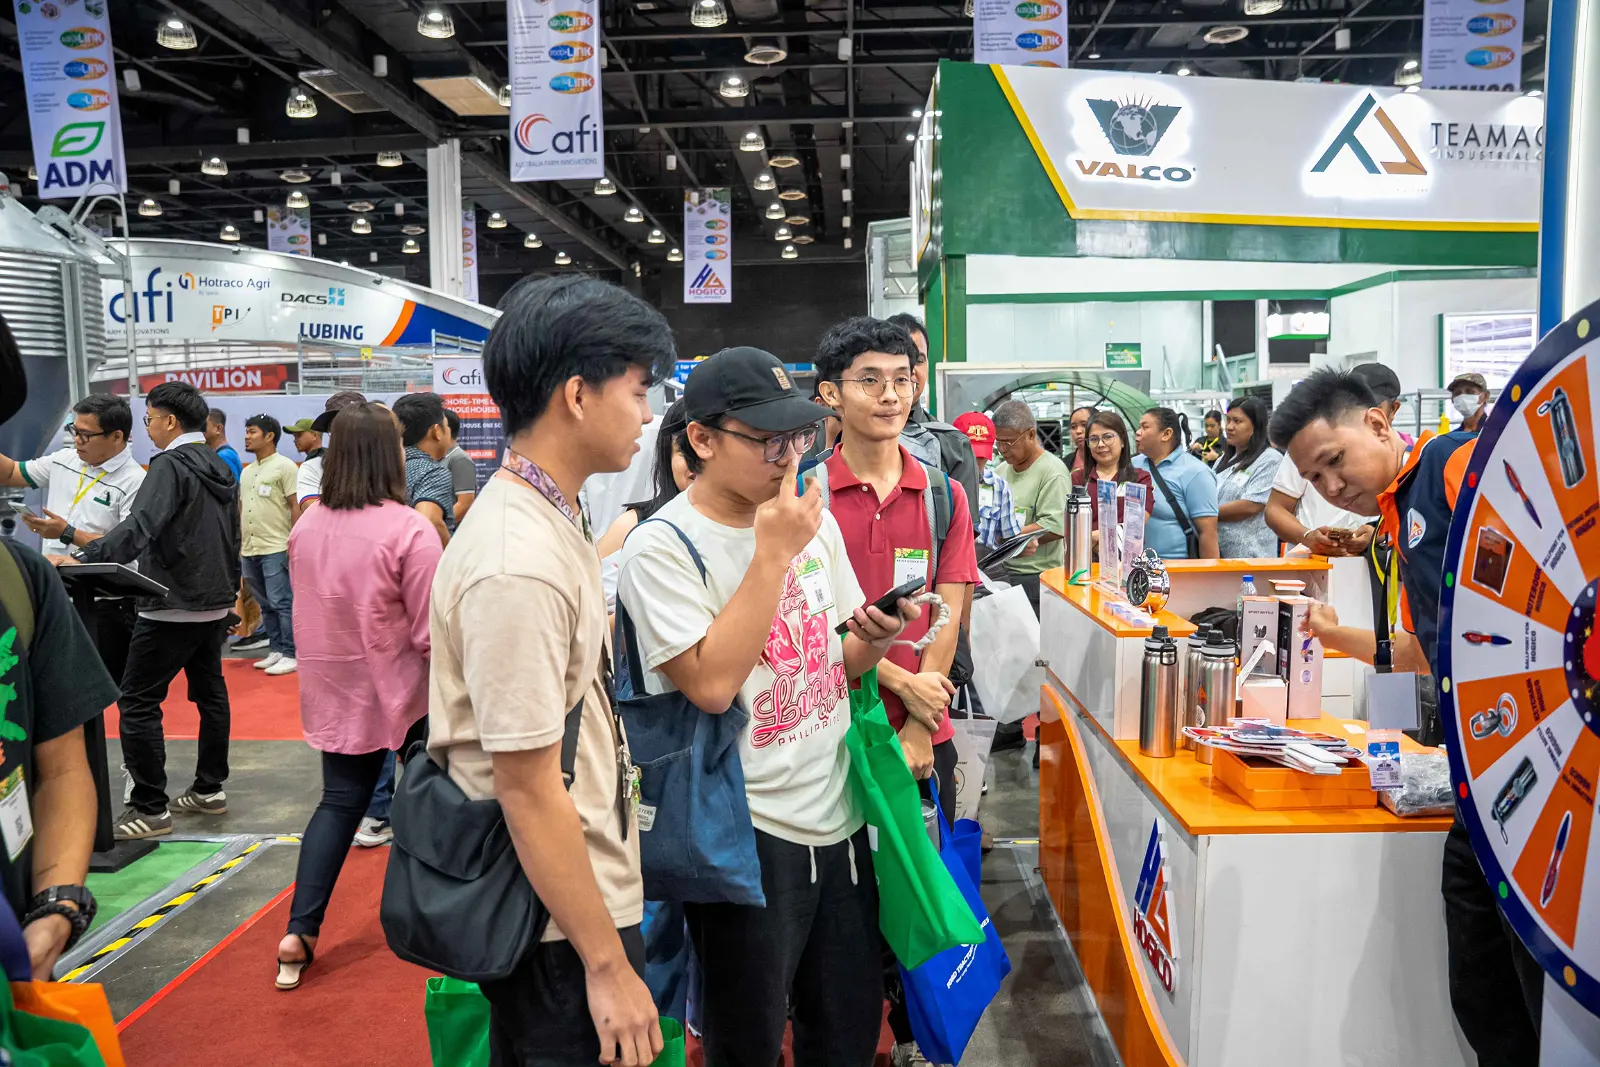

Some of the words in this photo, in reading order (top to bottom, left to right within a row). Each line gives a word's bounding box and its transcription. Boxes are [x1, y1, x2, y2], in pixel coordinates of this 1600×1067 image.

[43, 159, 114, 189] ADM
[1075, 159, 1192, 182] VALCO
[199, 276, 244, 288] Hotraco
[246, 278, 271, 291] Agri
[688, 288, 727, 296] HOGICO
[281, 292, 328, 305] DACS
[299, 322, 364, 341] LUBING
[165, 370, 262, 389] PAVILION
[1525, 565, 1542, 617] NOTEBOOK
[778, 713, 841, 747] PHILIPPIN
